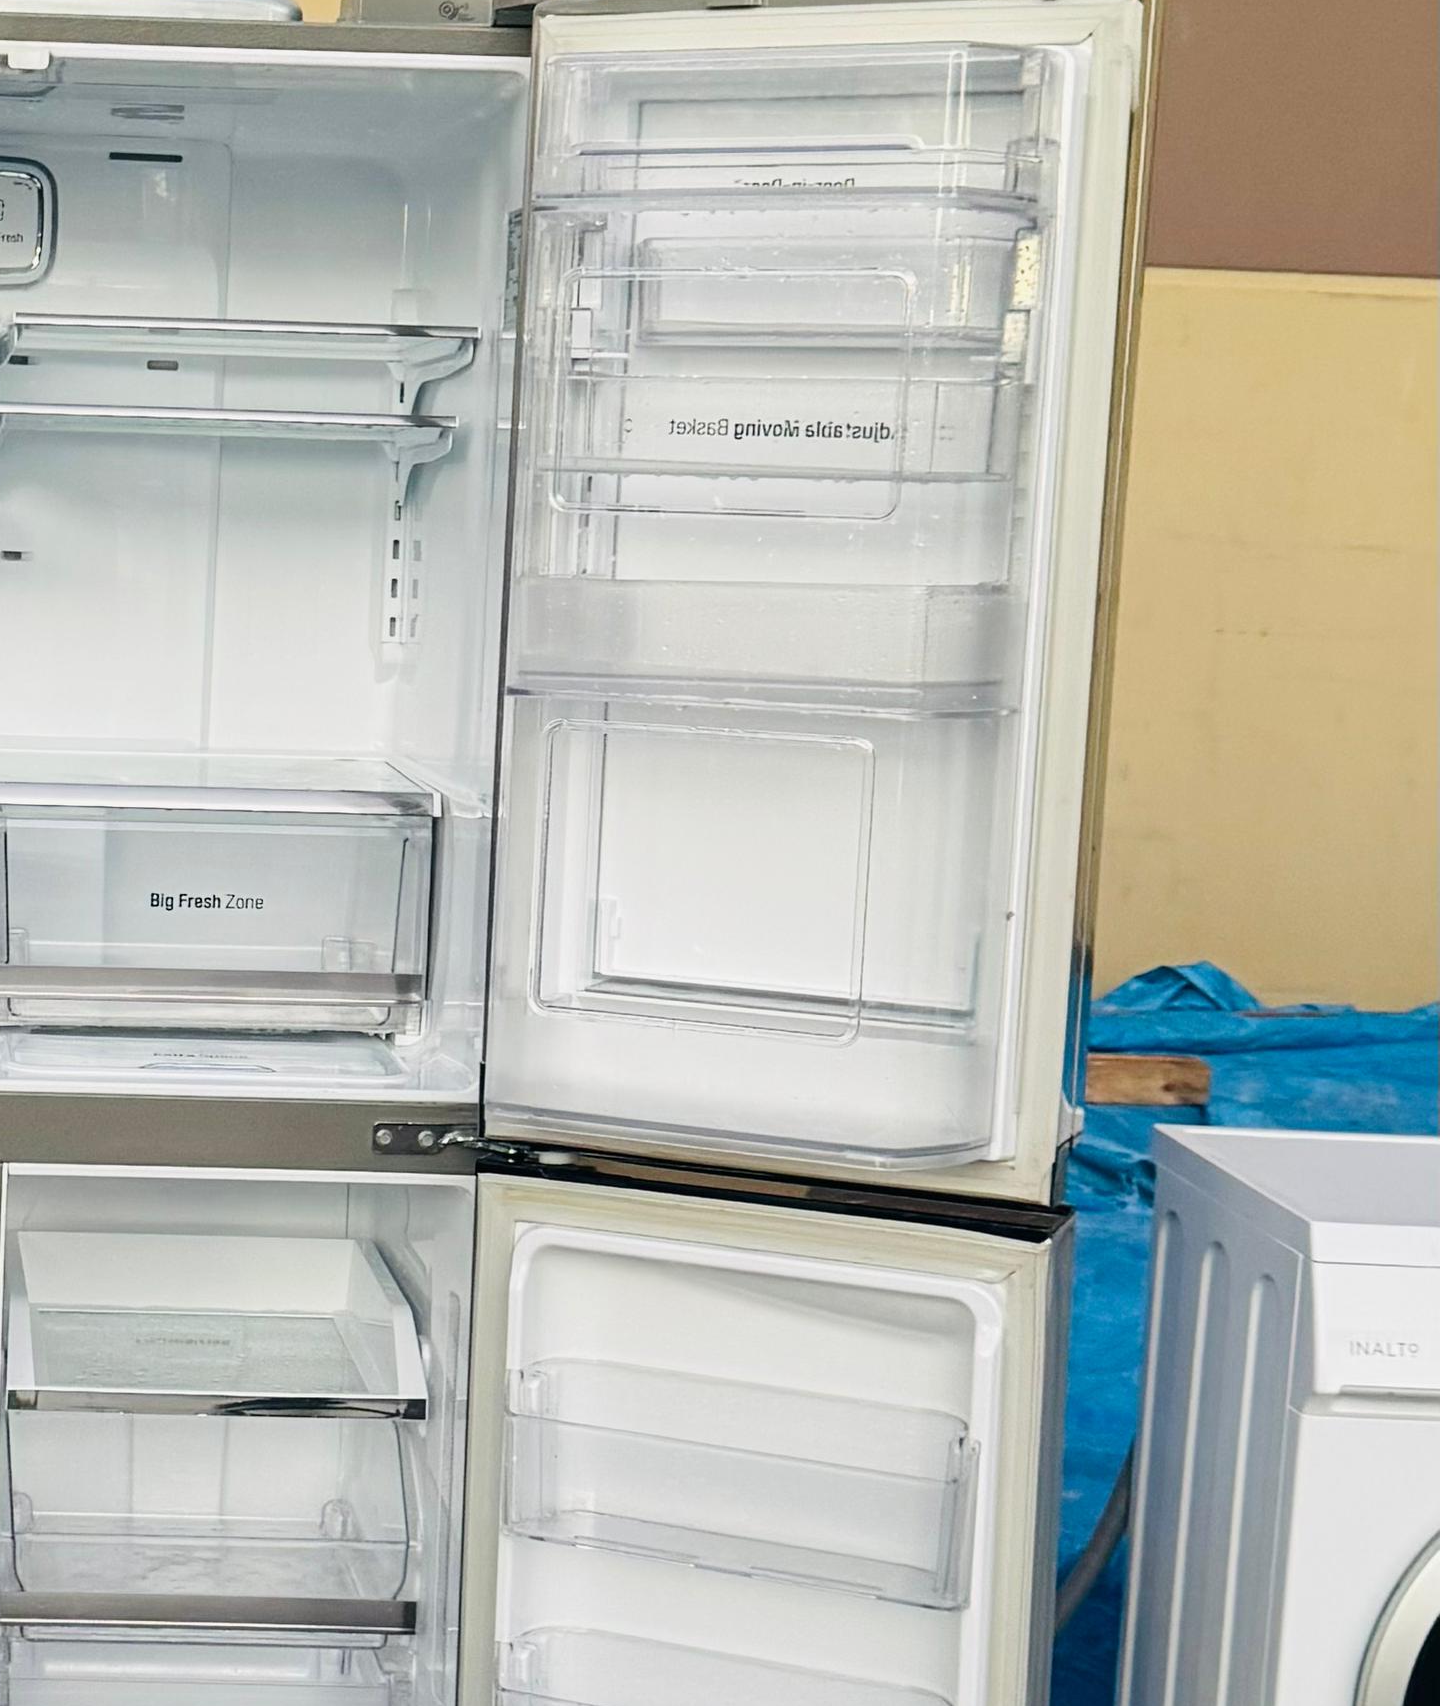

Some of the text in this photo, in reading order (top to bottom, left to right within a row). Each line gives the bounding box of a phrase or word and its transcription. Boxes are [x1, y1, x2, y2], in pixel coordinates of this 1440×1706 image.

[150, 892, 264, 911] Big Fresh Zone
